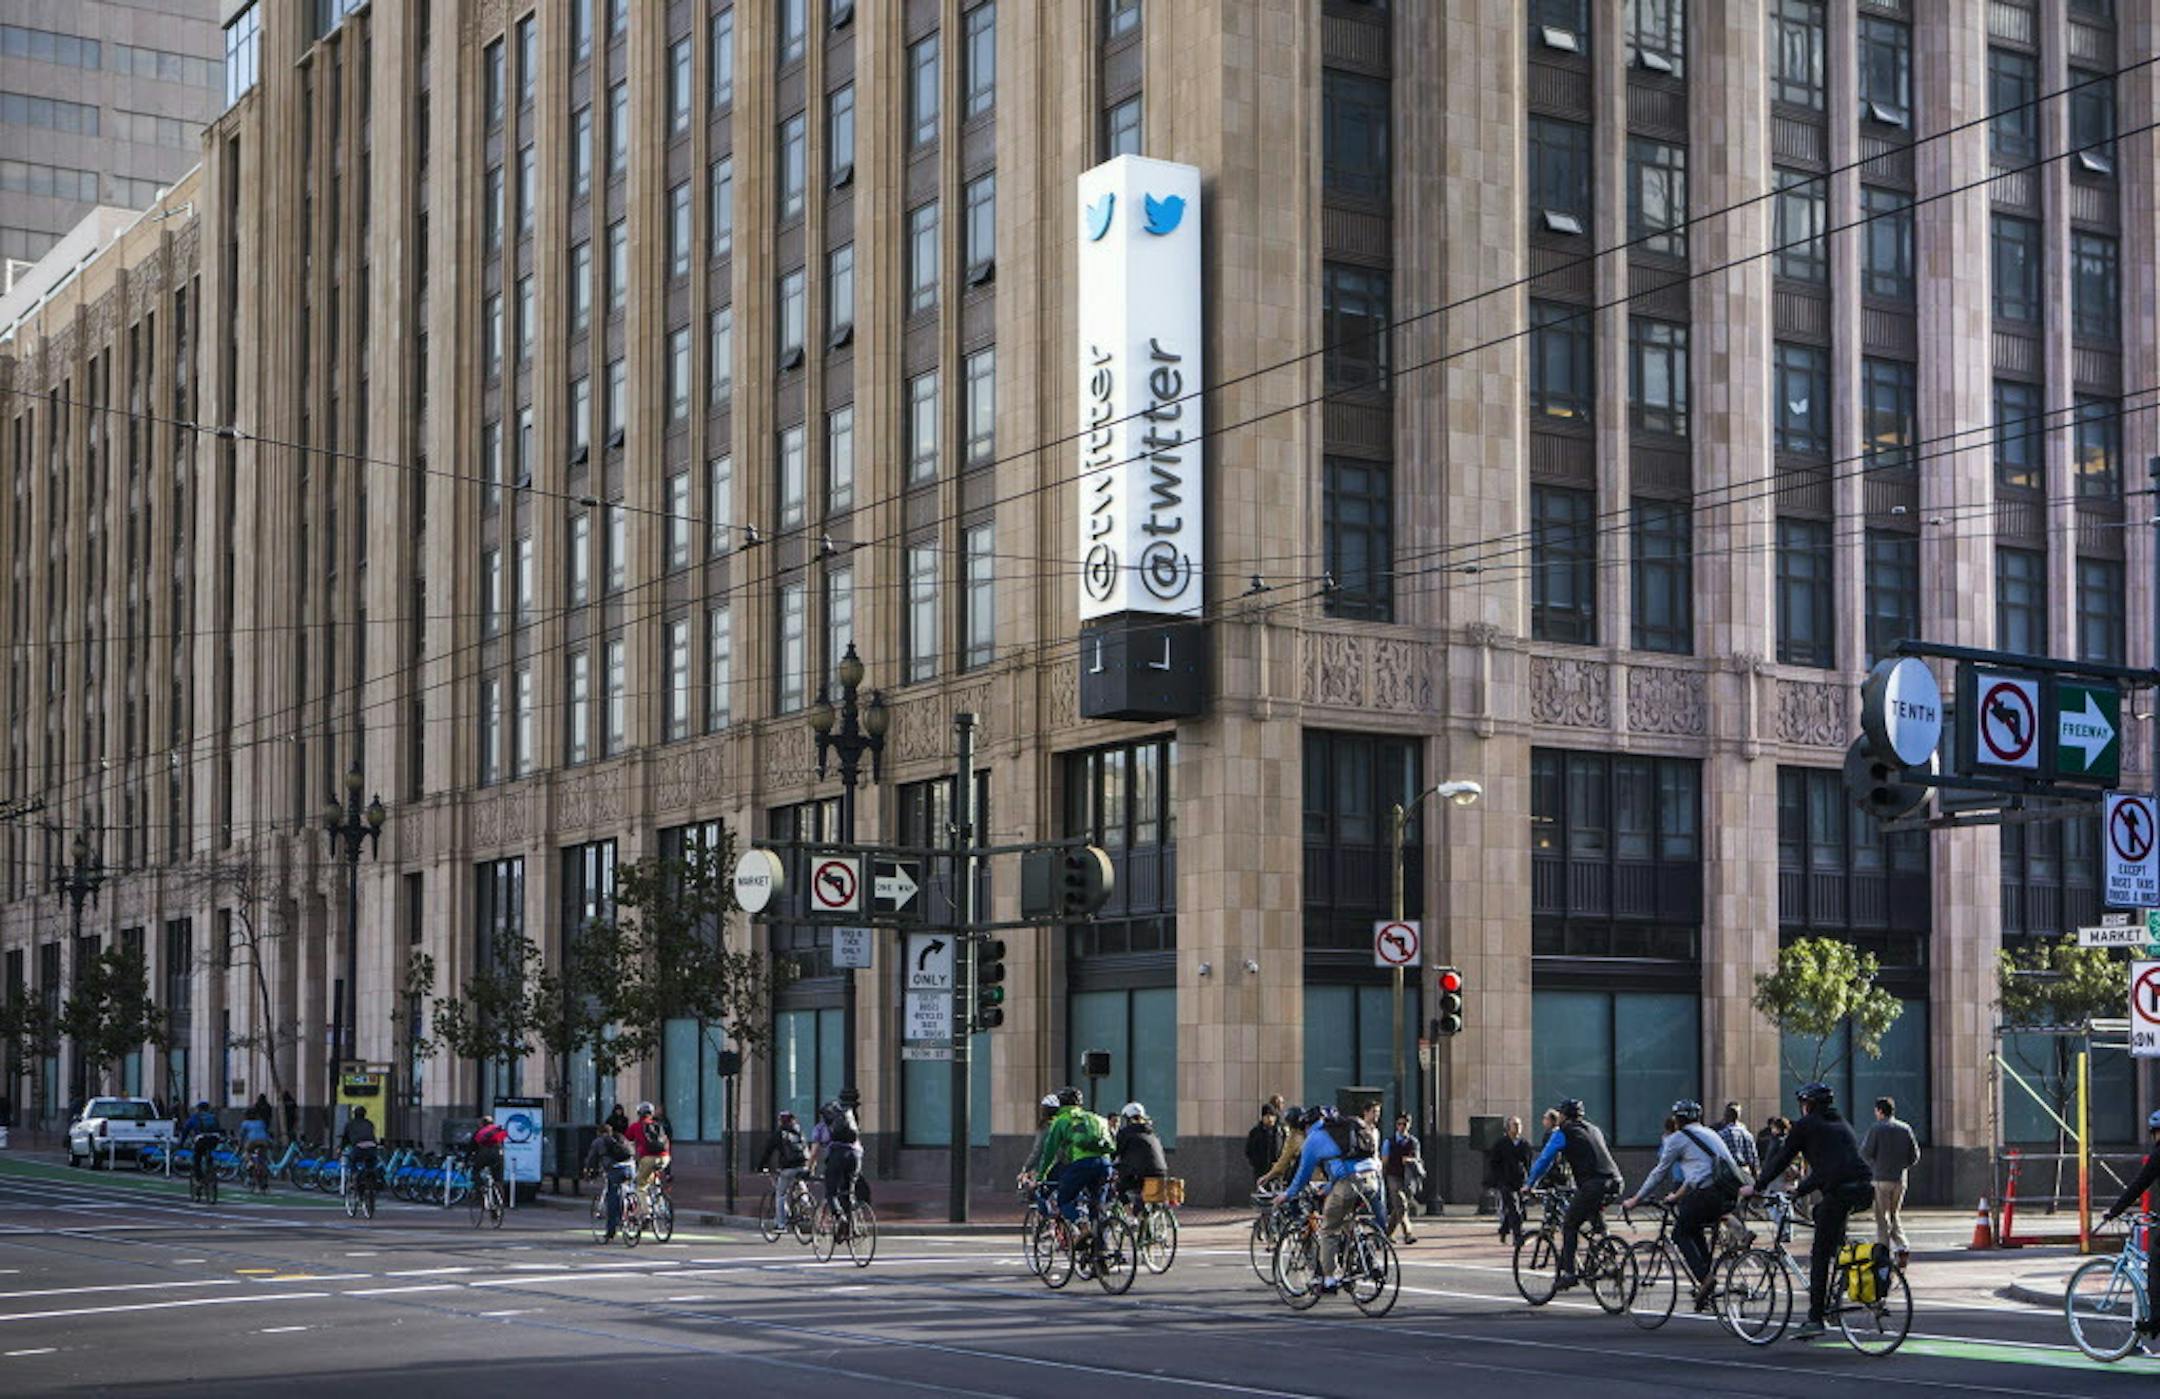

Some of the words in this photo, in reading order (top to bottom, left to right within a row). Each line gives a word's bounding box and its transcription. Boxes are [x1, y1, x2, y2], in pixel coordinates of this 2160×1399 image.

[1084, 345, 1117, 602] @twitter
[1139, 338, 1191, 601] @twitter
[1892, 700, 1936, 722] TENTH
[2062, 722, 2109, 740] FREEWAY
[737, 875, 769, 887] MARKET
[876, 883, 892, 892] ONE
[2090, 929, 2141, 943] MARKET
[913, 973, 947, 986] ONLY
